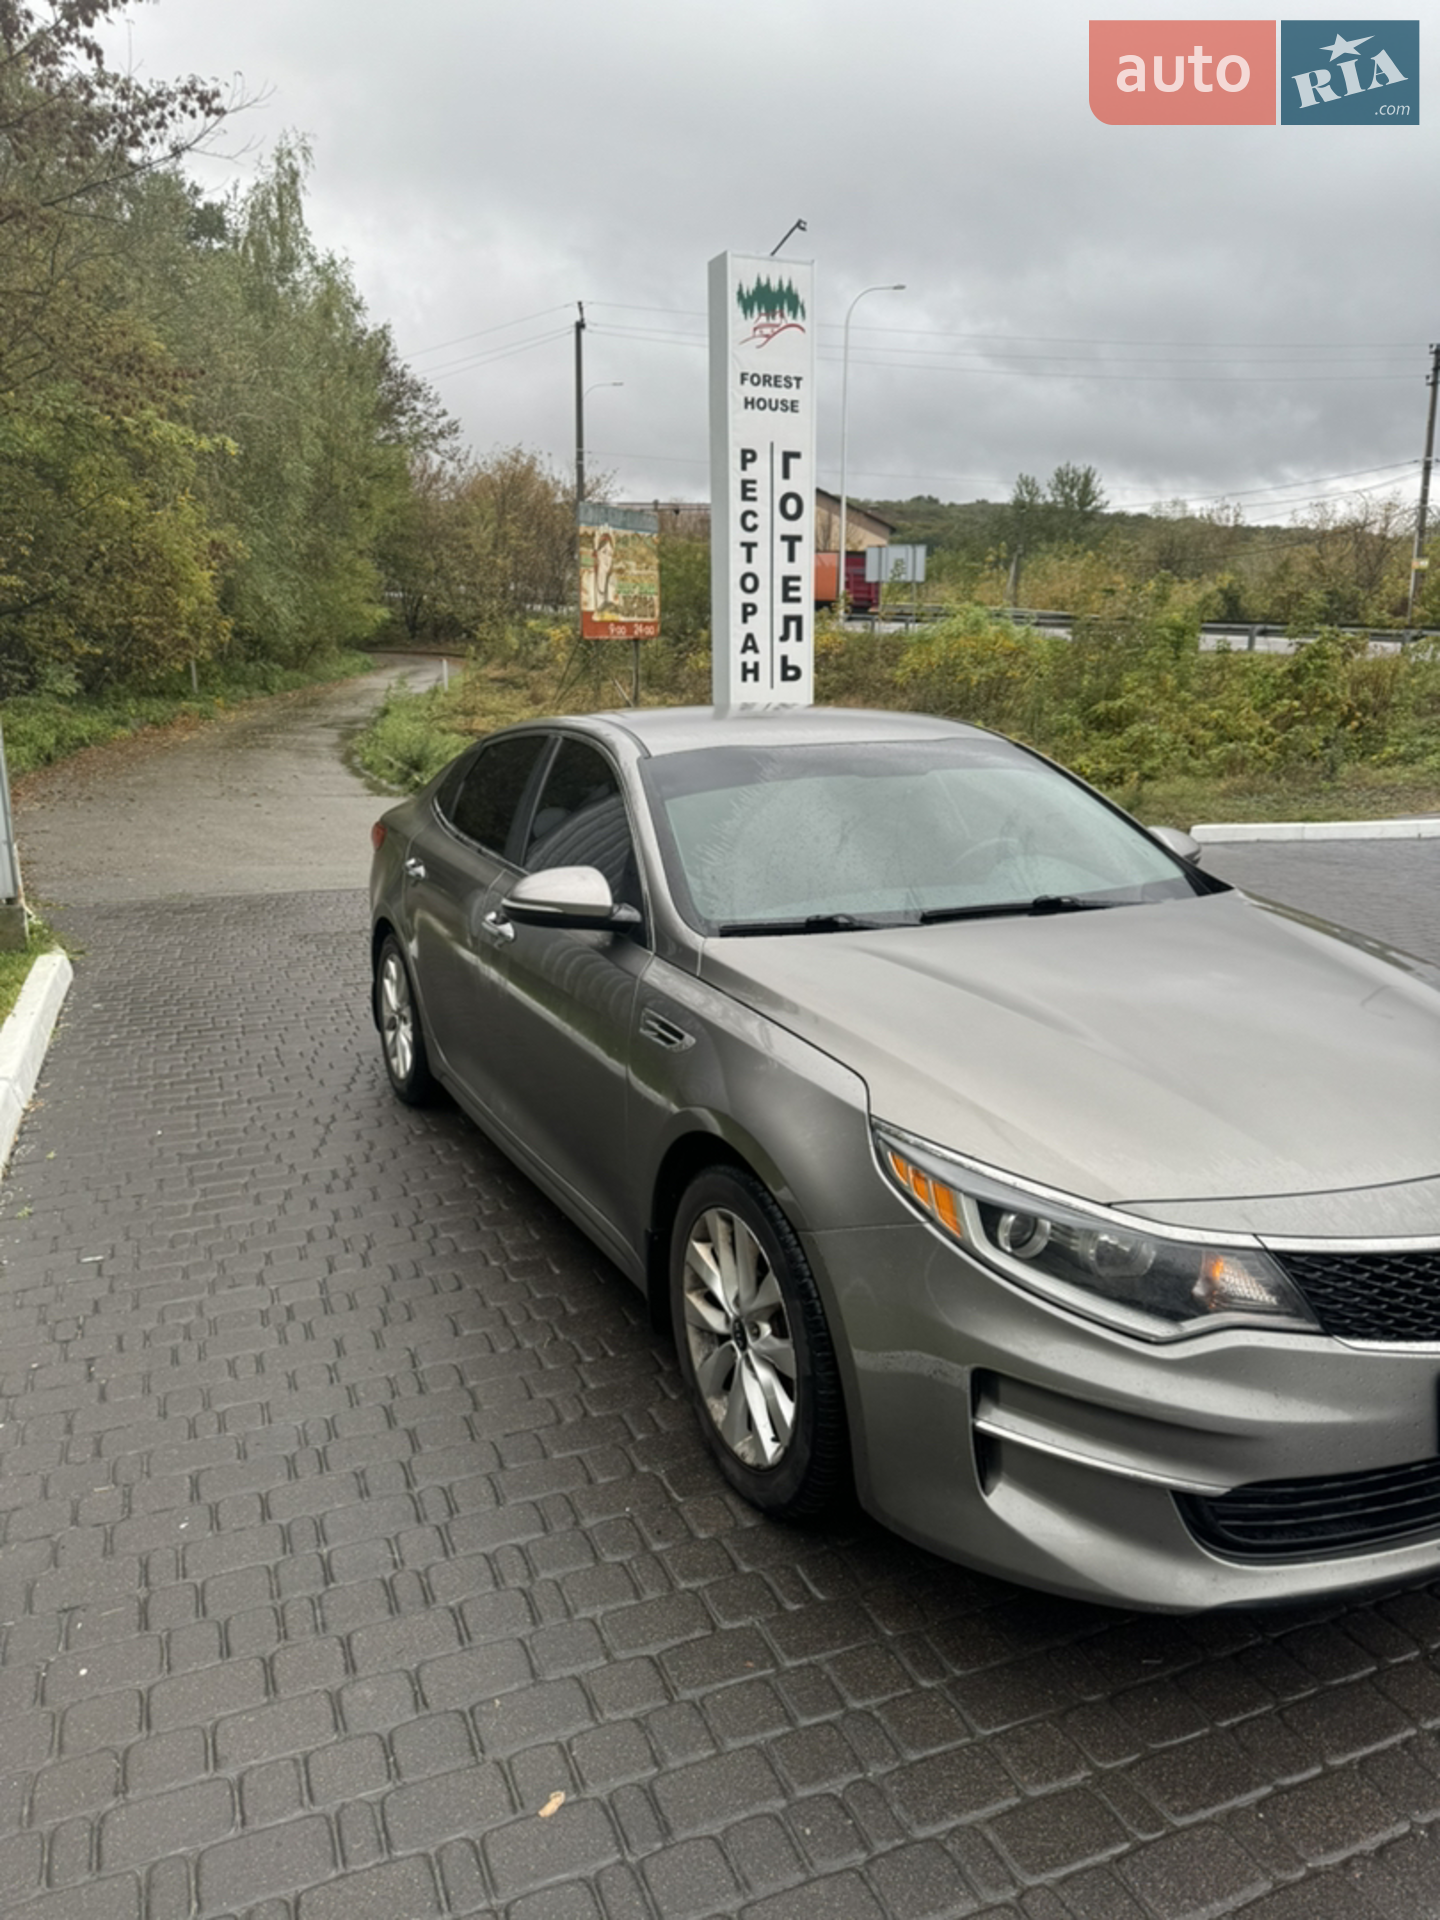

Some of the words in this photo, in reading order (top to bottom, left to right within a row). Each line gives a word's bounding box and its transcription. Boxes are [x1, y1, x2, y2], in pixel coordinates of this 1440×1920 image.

[740, 372, 803, 390] FOREST
[743, 396, 800, 413] HOUSE
[740, 448, 760, 683] РЕСТОРАН
[779, 450, 804, 682] ГОТЕЛЬ
